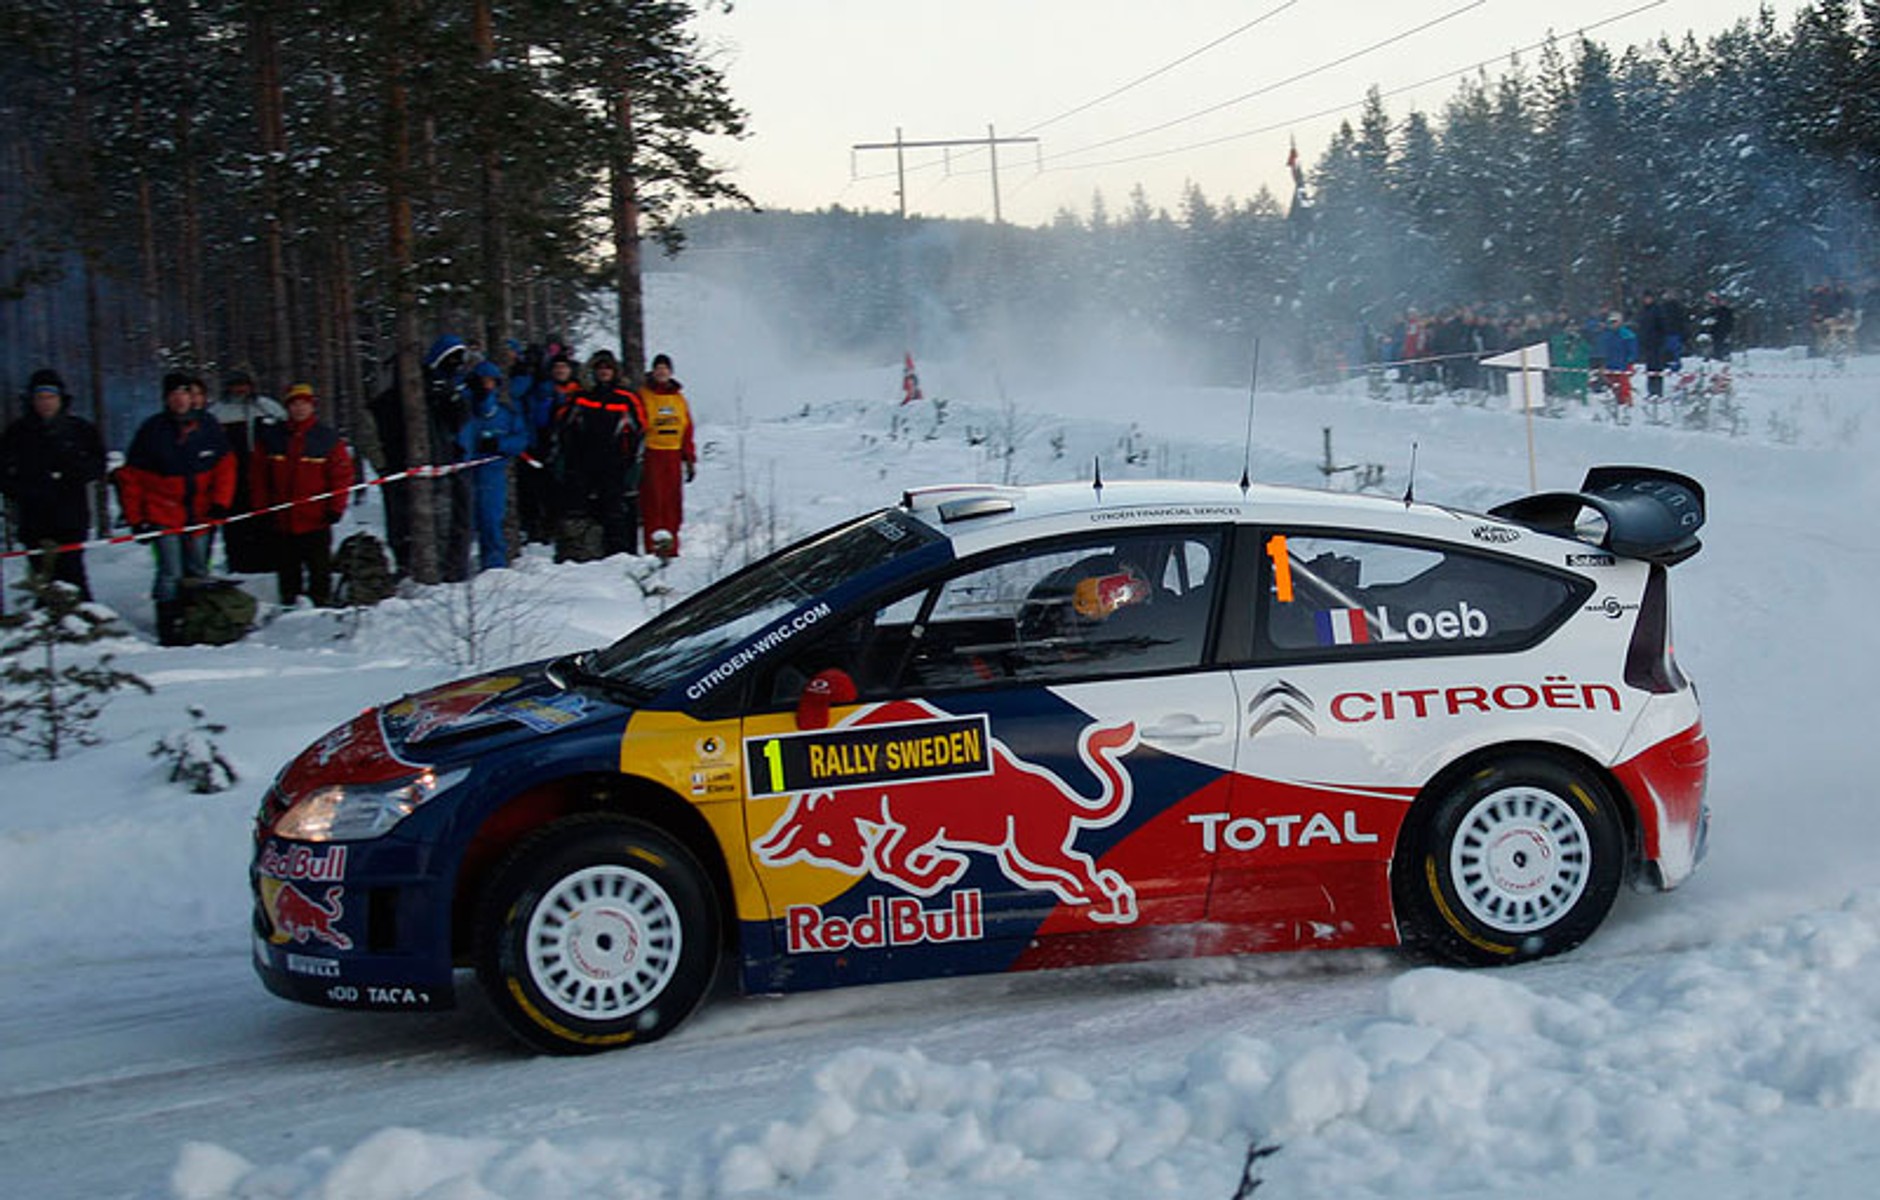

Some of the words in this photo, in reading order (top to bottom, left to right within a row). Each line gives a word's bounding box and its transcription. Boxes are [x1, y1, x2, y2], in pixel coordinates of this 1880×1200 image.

[1137, 506, 1191, 519] FINANCIAL
[1193, 505, 1243, 517] SERVICES
[1266, 534, 1294, 602] 1
[1377, 601, 1489, 642] Loeb
[685, 602, 833, 700] CITROEN-WRC.COM
[702, 737, 717, 753] 6
[763, 739, 785, 793] 1
[808, 743, 880, 779] RALLY
[885, 728, 981, 770] SWEDEN
[1188, 810, 1379, 853] TOTAL
[291, 845, 348, 881] Bull
[787, 895, 887, 954] Red
[887, 887, 985, 946] Bull
